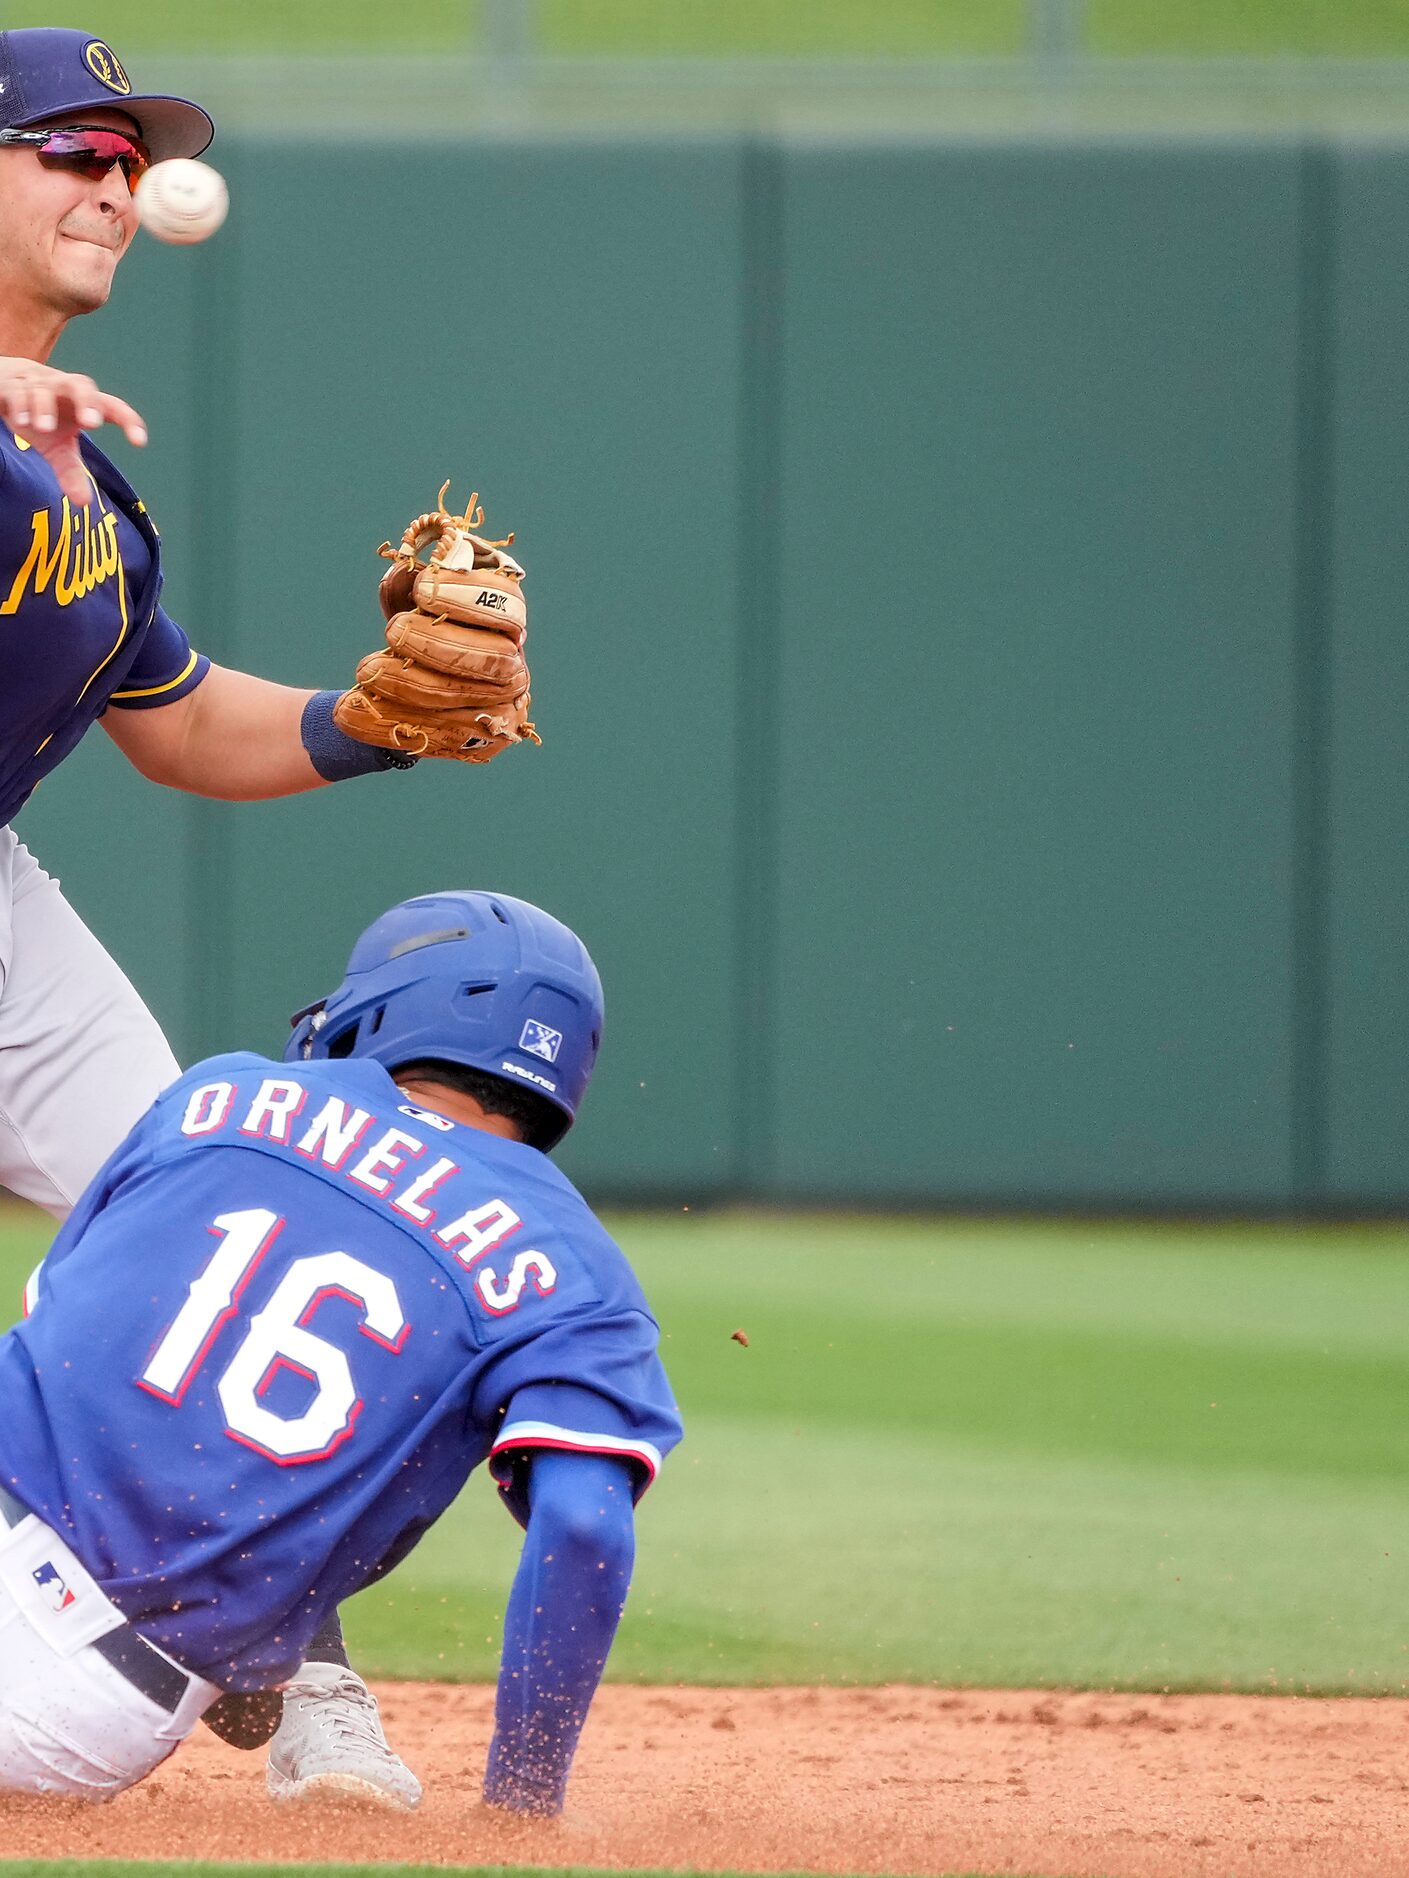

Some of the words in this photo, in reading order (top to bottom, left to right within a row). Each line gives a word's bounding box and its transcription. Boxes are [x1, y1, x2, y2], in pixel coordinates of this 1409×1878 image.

[475, 590, 508, 612] A2K
[180, 1079, 558, 1317] ORNELAS
[136, 1207, 412, 1467] 16
